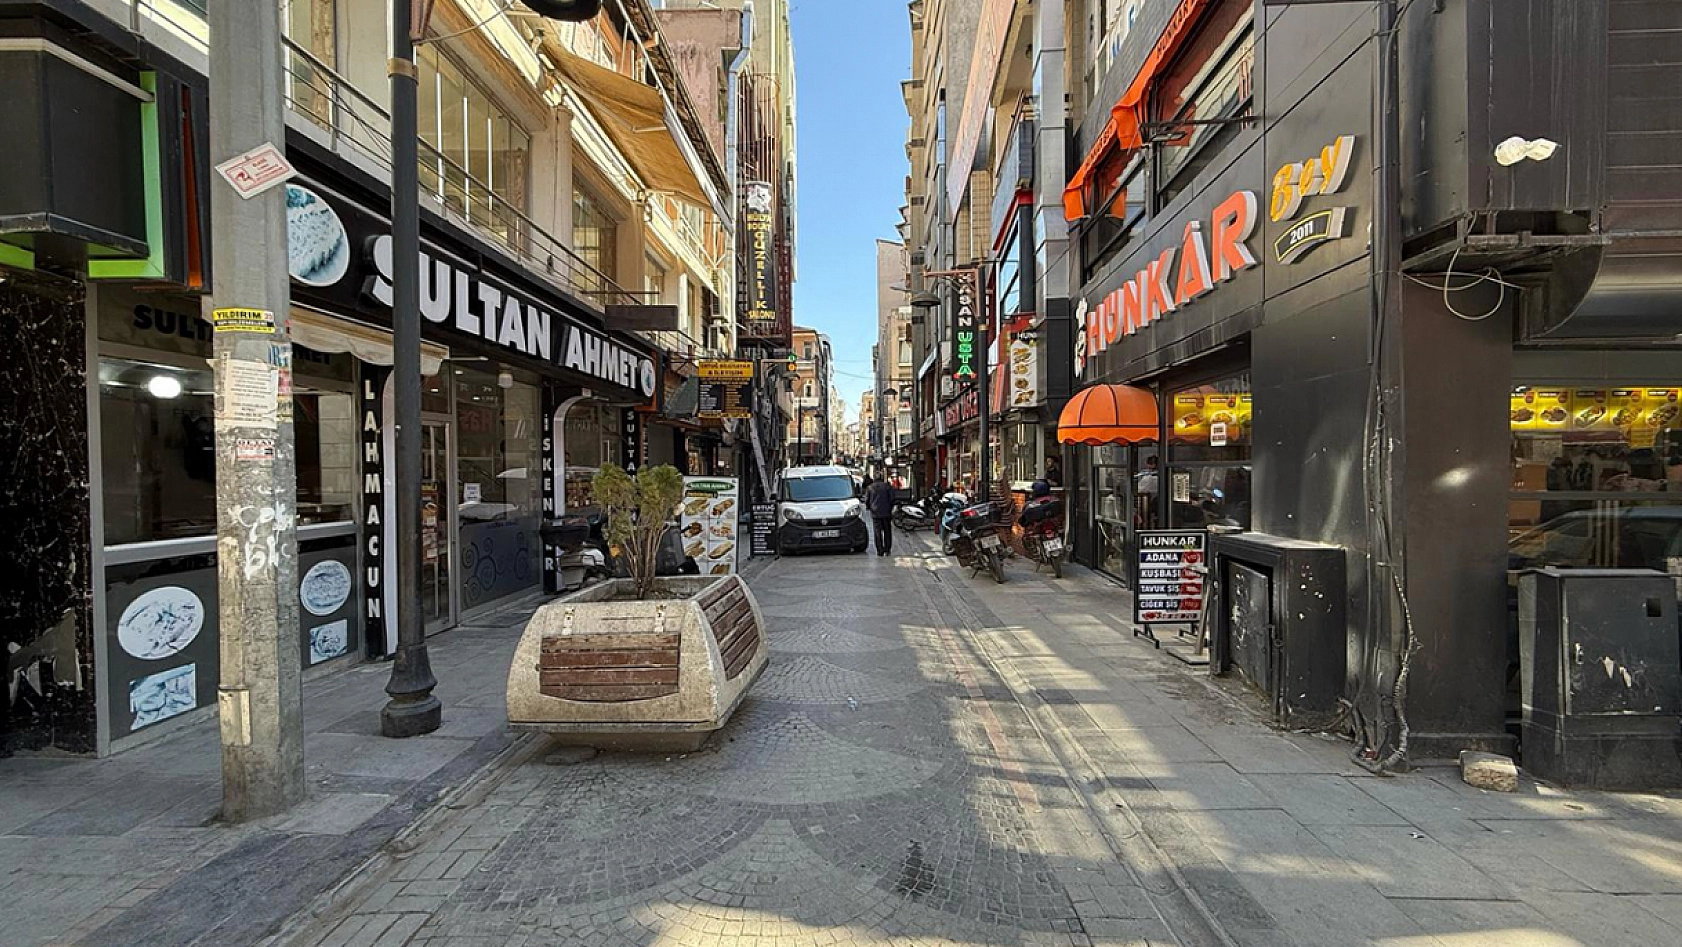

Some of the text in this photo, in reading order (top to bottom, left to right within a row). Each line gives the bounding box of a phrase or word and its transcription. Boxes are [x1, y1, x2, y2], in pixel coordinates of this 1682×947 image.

[1289, 220, 1314, 245] 2011
[133, 304, 213, 341] SULT
[562, 325, 639, 390] AHMET
[364, 379, 381, 618] LAHMACUN
[1145, 552, 1179, 562] ADANA
[1141, 584, 1166, 592] TAVUK
